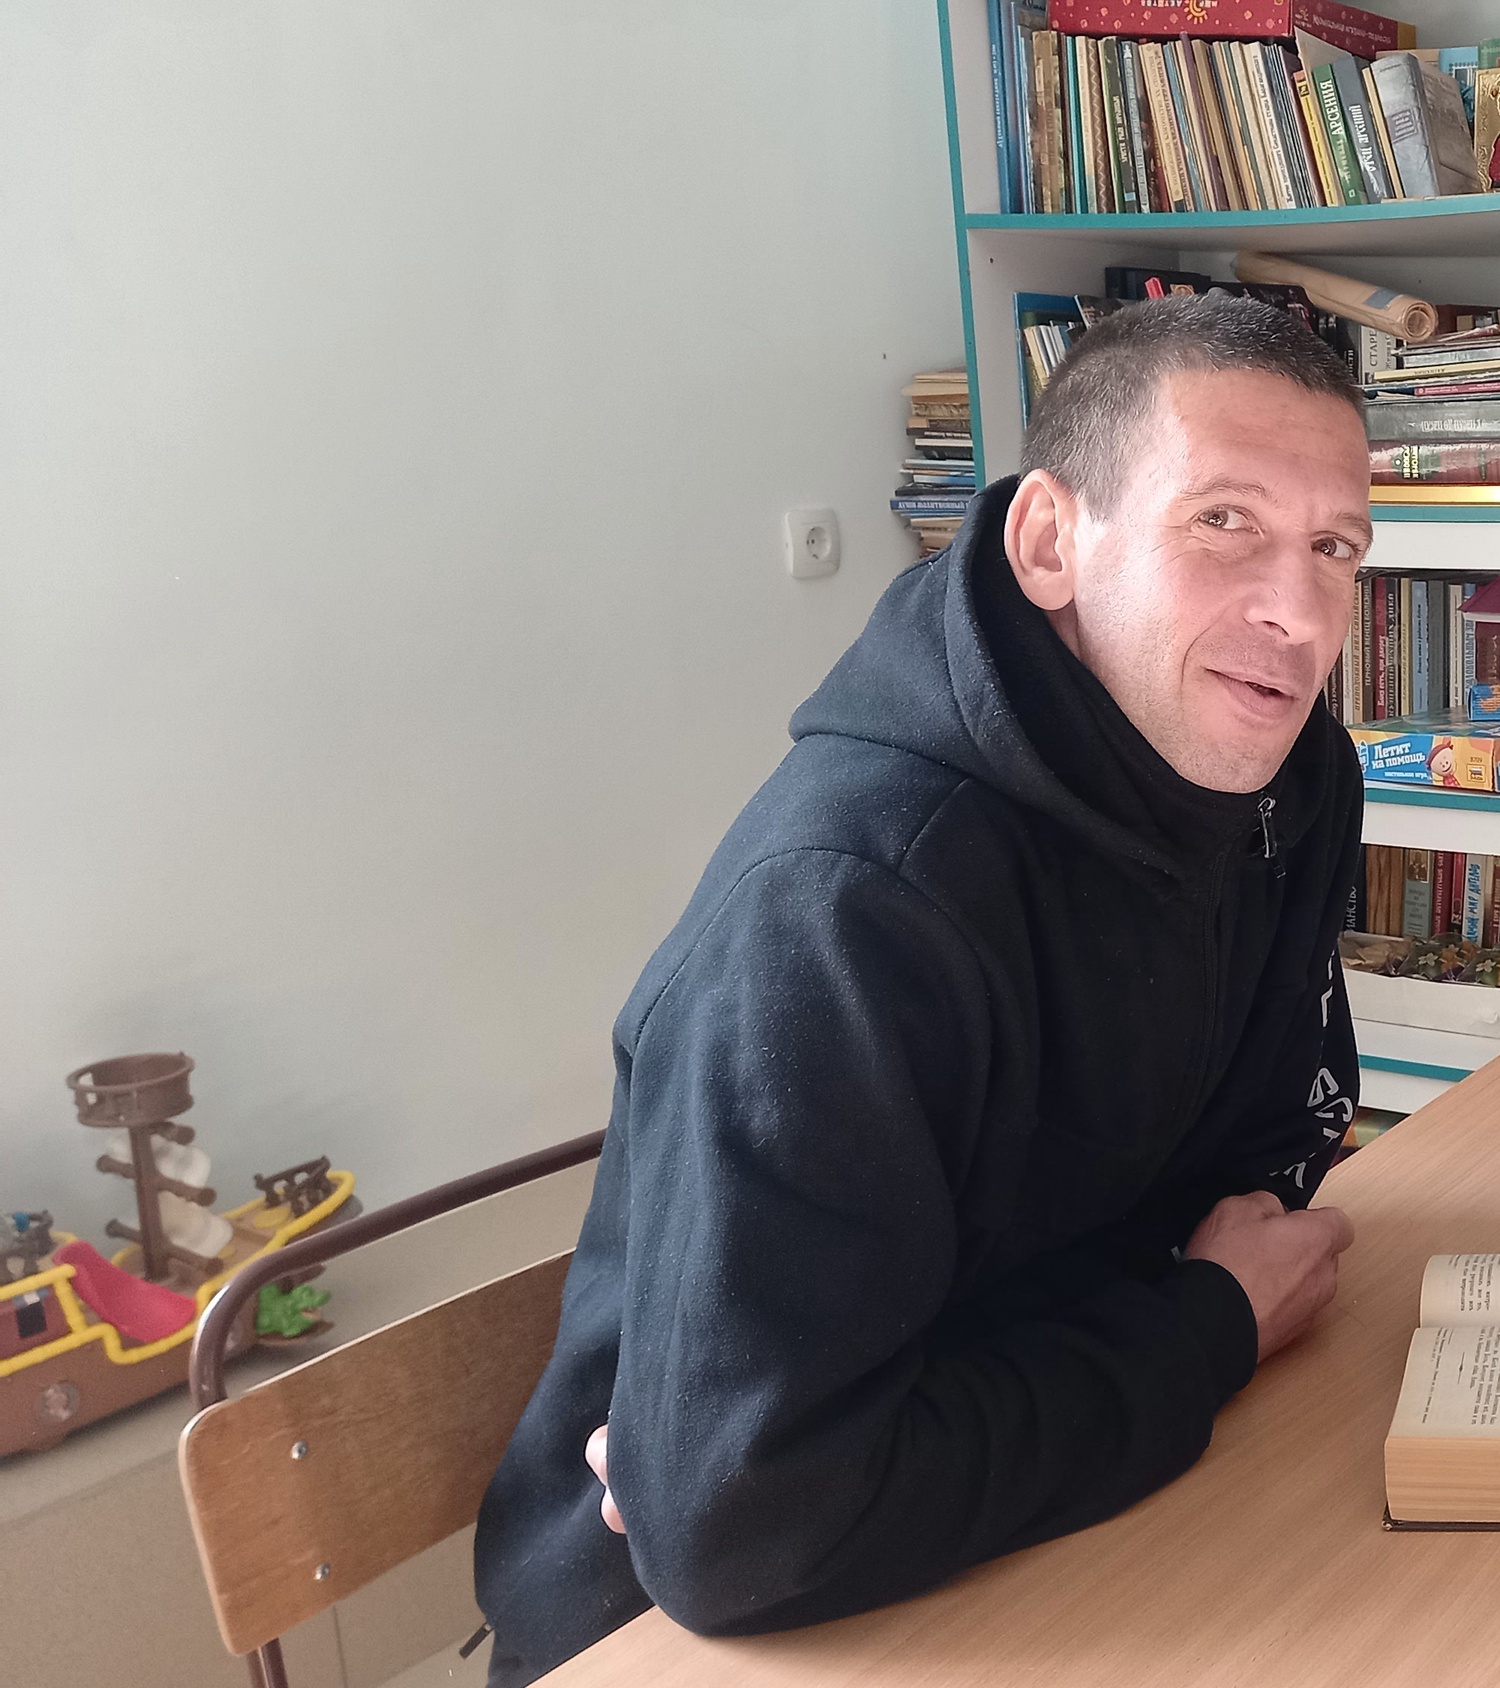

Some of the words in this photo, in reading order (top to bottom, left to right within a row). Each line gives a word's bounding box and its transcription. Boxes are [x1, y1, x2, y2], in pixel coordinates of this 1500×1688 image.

[1319, 78, 1344, 136] АРСЕНИЯ
[1374, 742, 1411, 760] Летит
[1372, 760, 1385, 770] на
[1385, 752, 1426, 767] помощь
